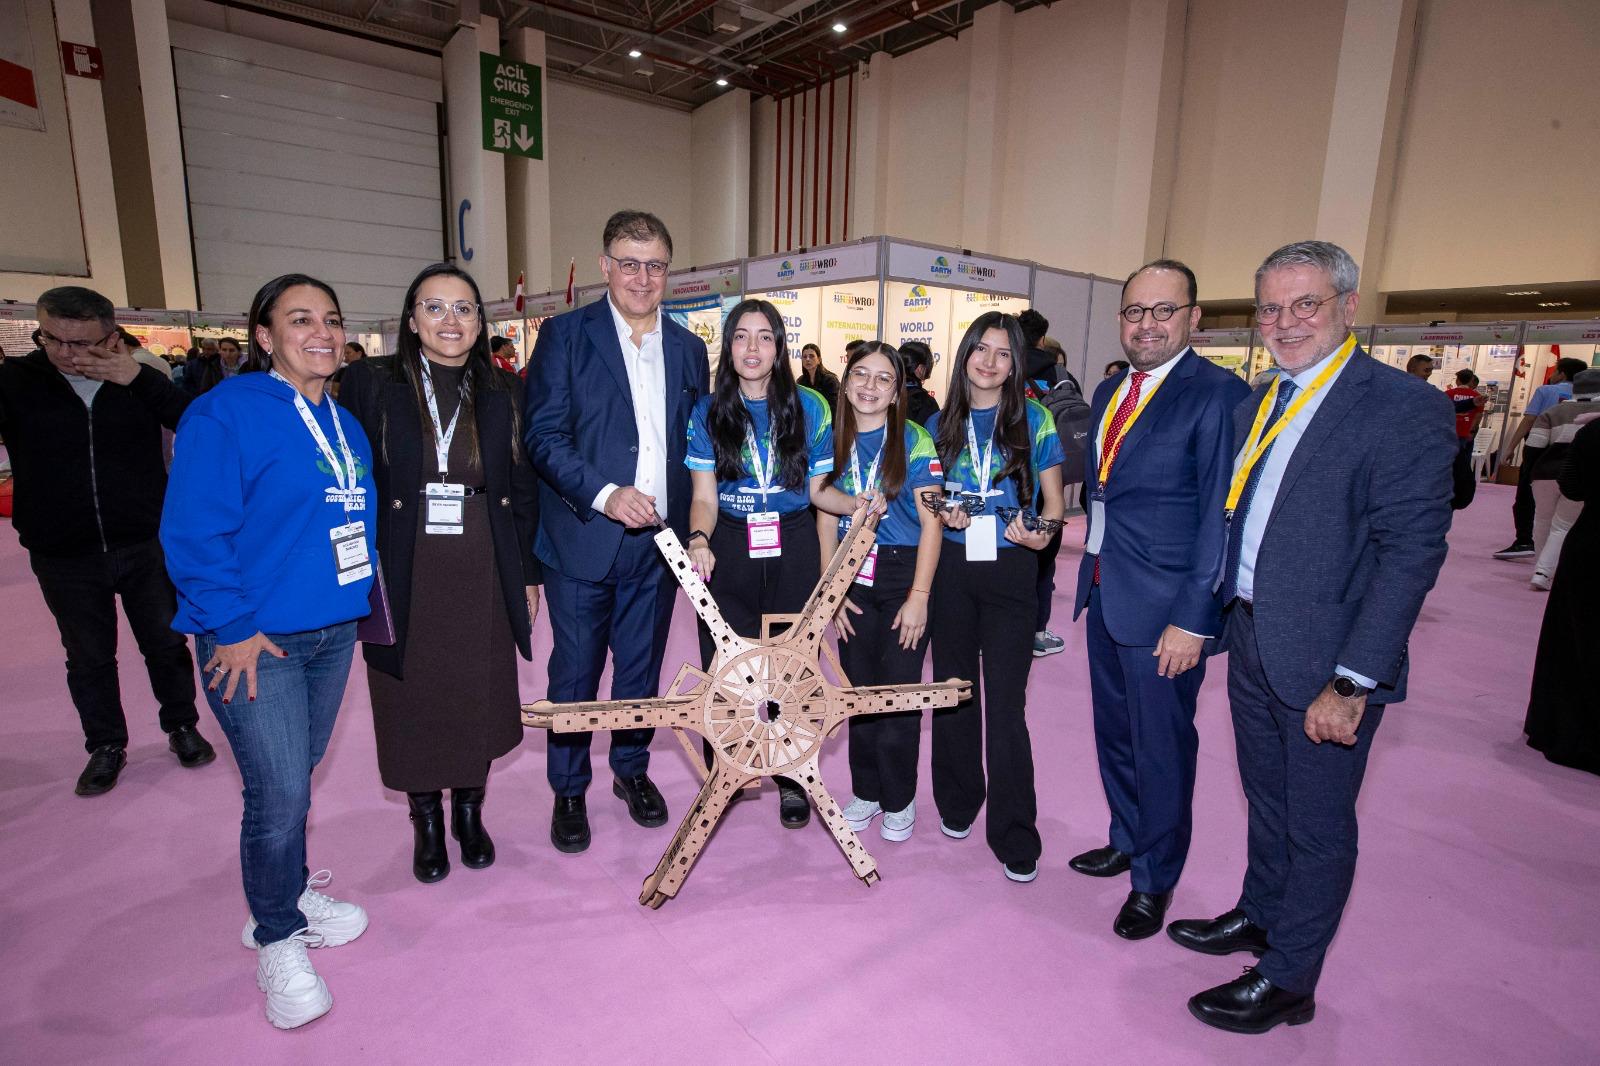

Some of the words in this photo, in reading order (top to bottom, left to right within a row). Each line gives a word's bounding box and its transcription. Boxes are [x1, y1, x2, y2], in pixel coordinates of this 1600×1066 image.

[496, 64, 527, 81] ACİL
[493, 77, 530, 97] ÇIKIŞ
[490, 96, 534, 111] EMERGENCY
[505, 107, 520, 116] EXIT
[459, 199, 473, 261] C
[777, 269, 794, 278] EARTH
[930, 265, 952, 275] EARTH
[766, 290, 798, 300] EARTH
[854, 296, 872, 307] WRO
[904, 297, 931, 307] EARTH
[783, 315, 802, 328] RLD
[827, 320, 877, 331] INTERNATIONA
[900, 321, 934, 333] WORLD
[737, 495, 755, 504] RICA
[732, 504, 754, 513] TEAM
